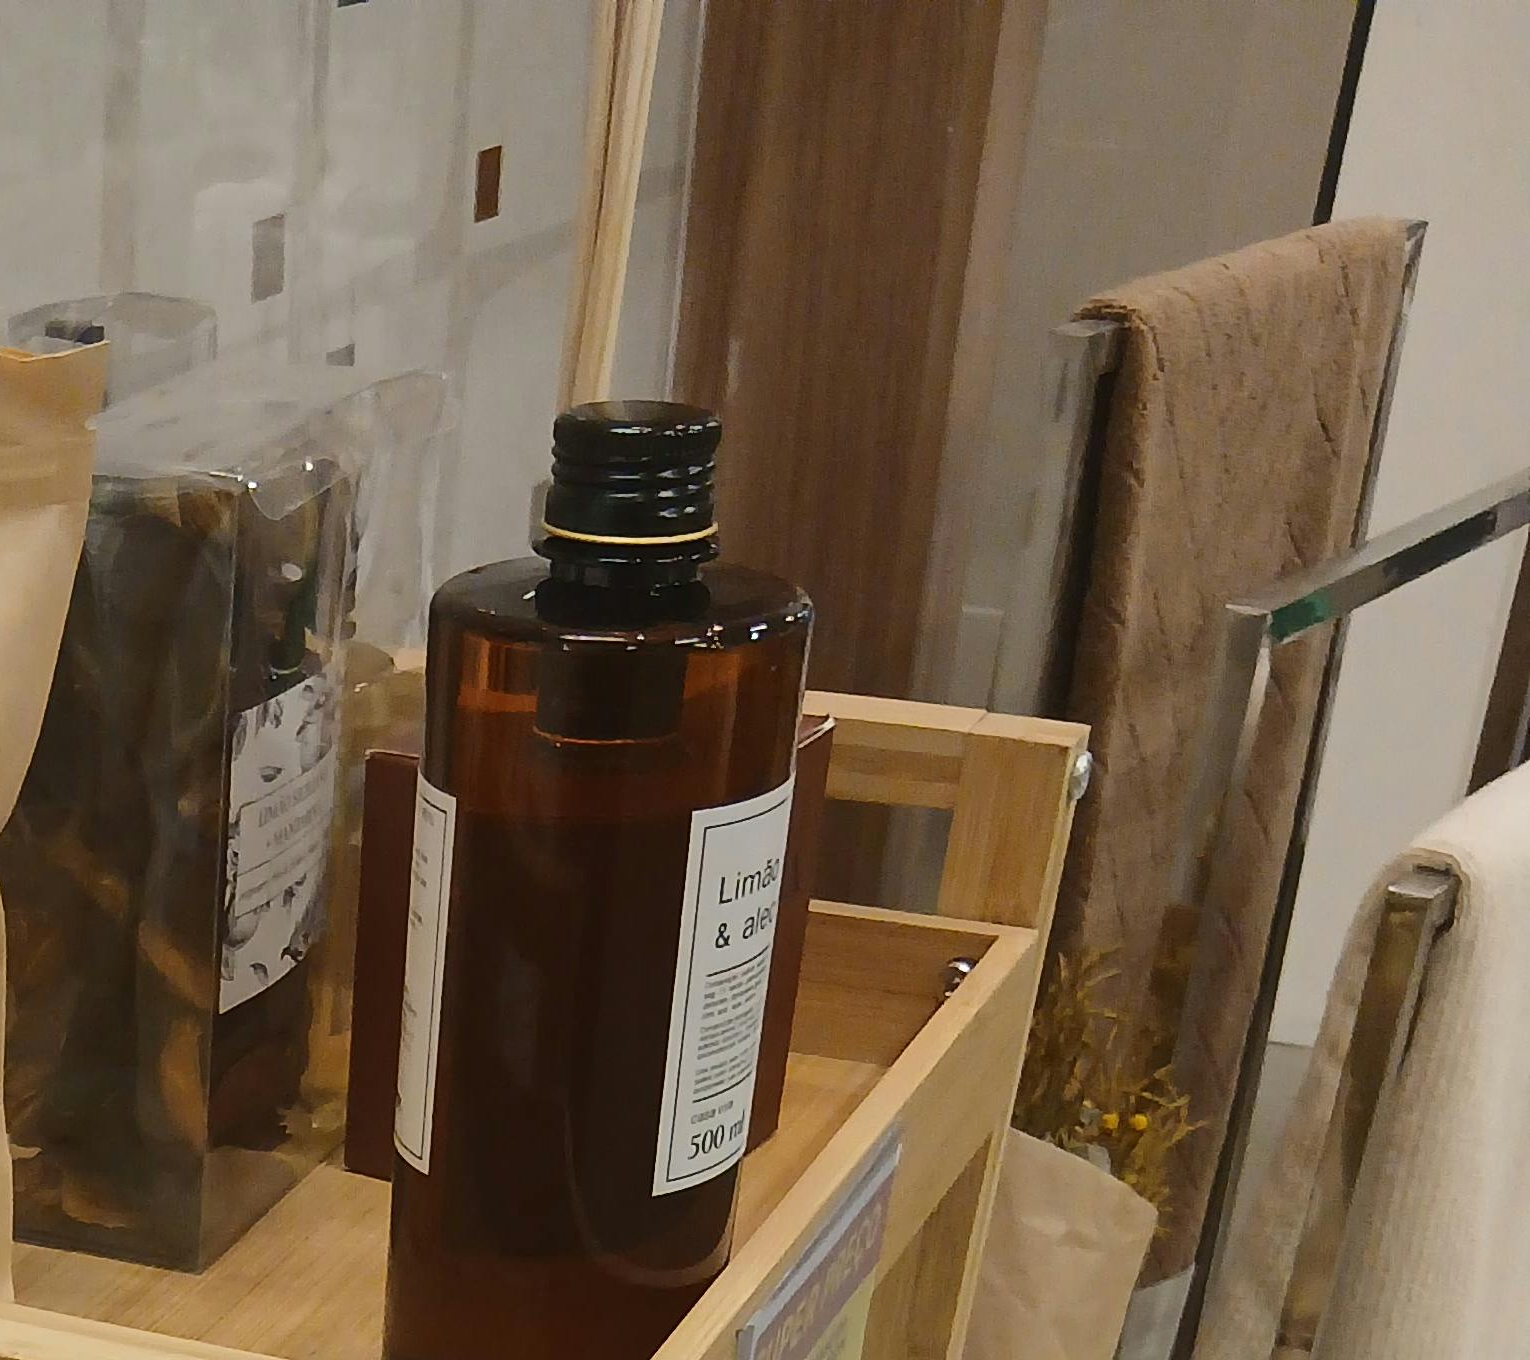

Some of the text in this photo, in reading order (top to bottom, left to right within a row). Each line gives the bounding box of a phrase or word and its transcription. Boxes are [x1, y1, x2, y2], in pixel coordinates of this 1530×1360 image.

[718, 858, 780, 905] Limão
[714, 921, 732, 949] &
[687, 1124, 725, 1160] 500
